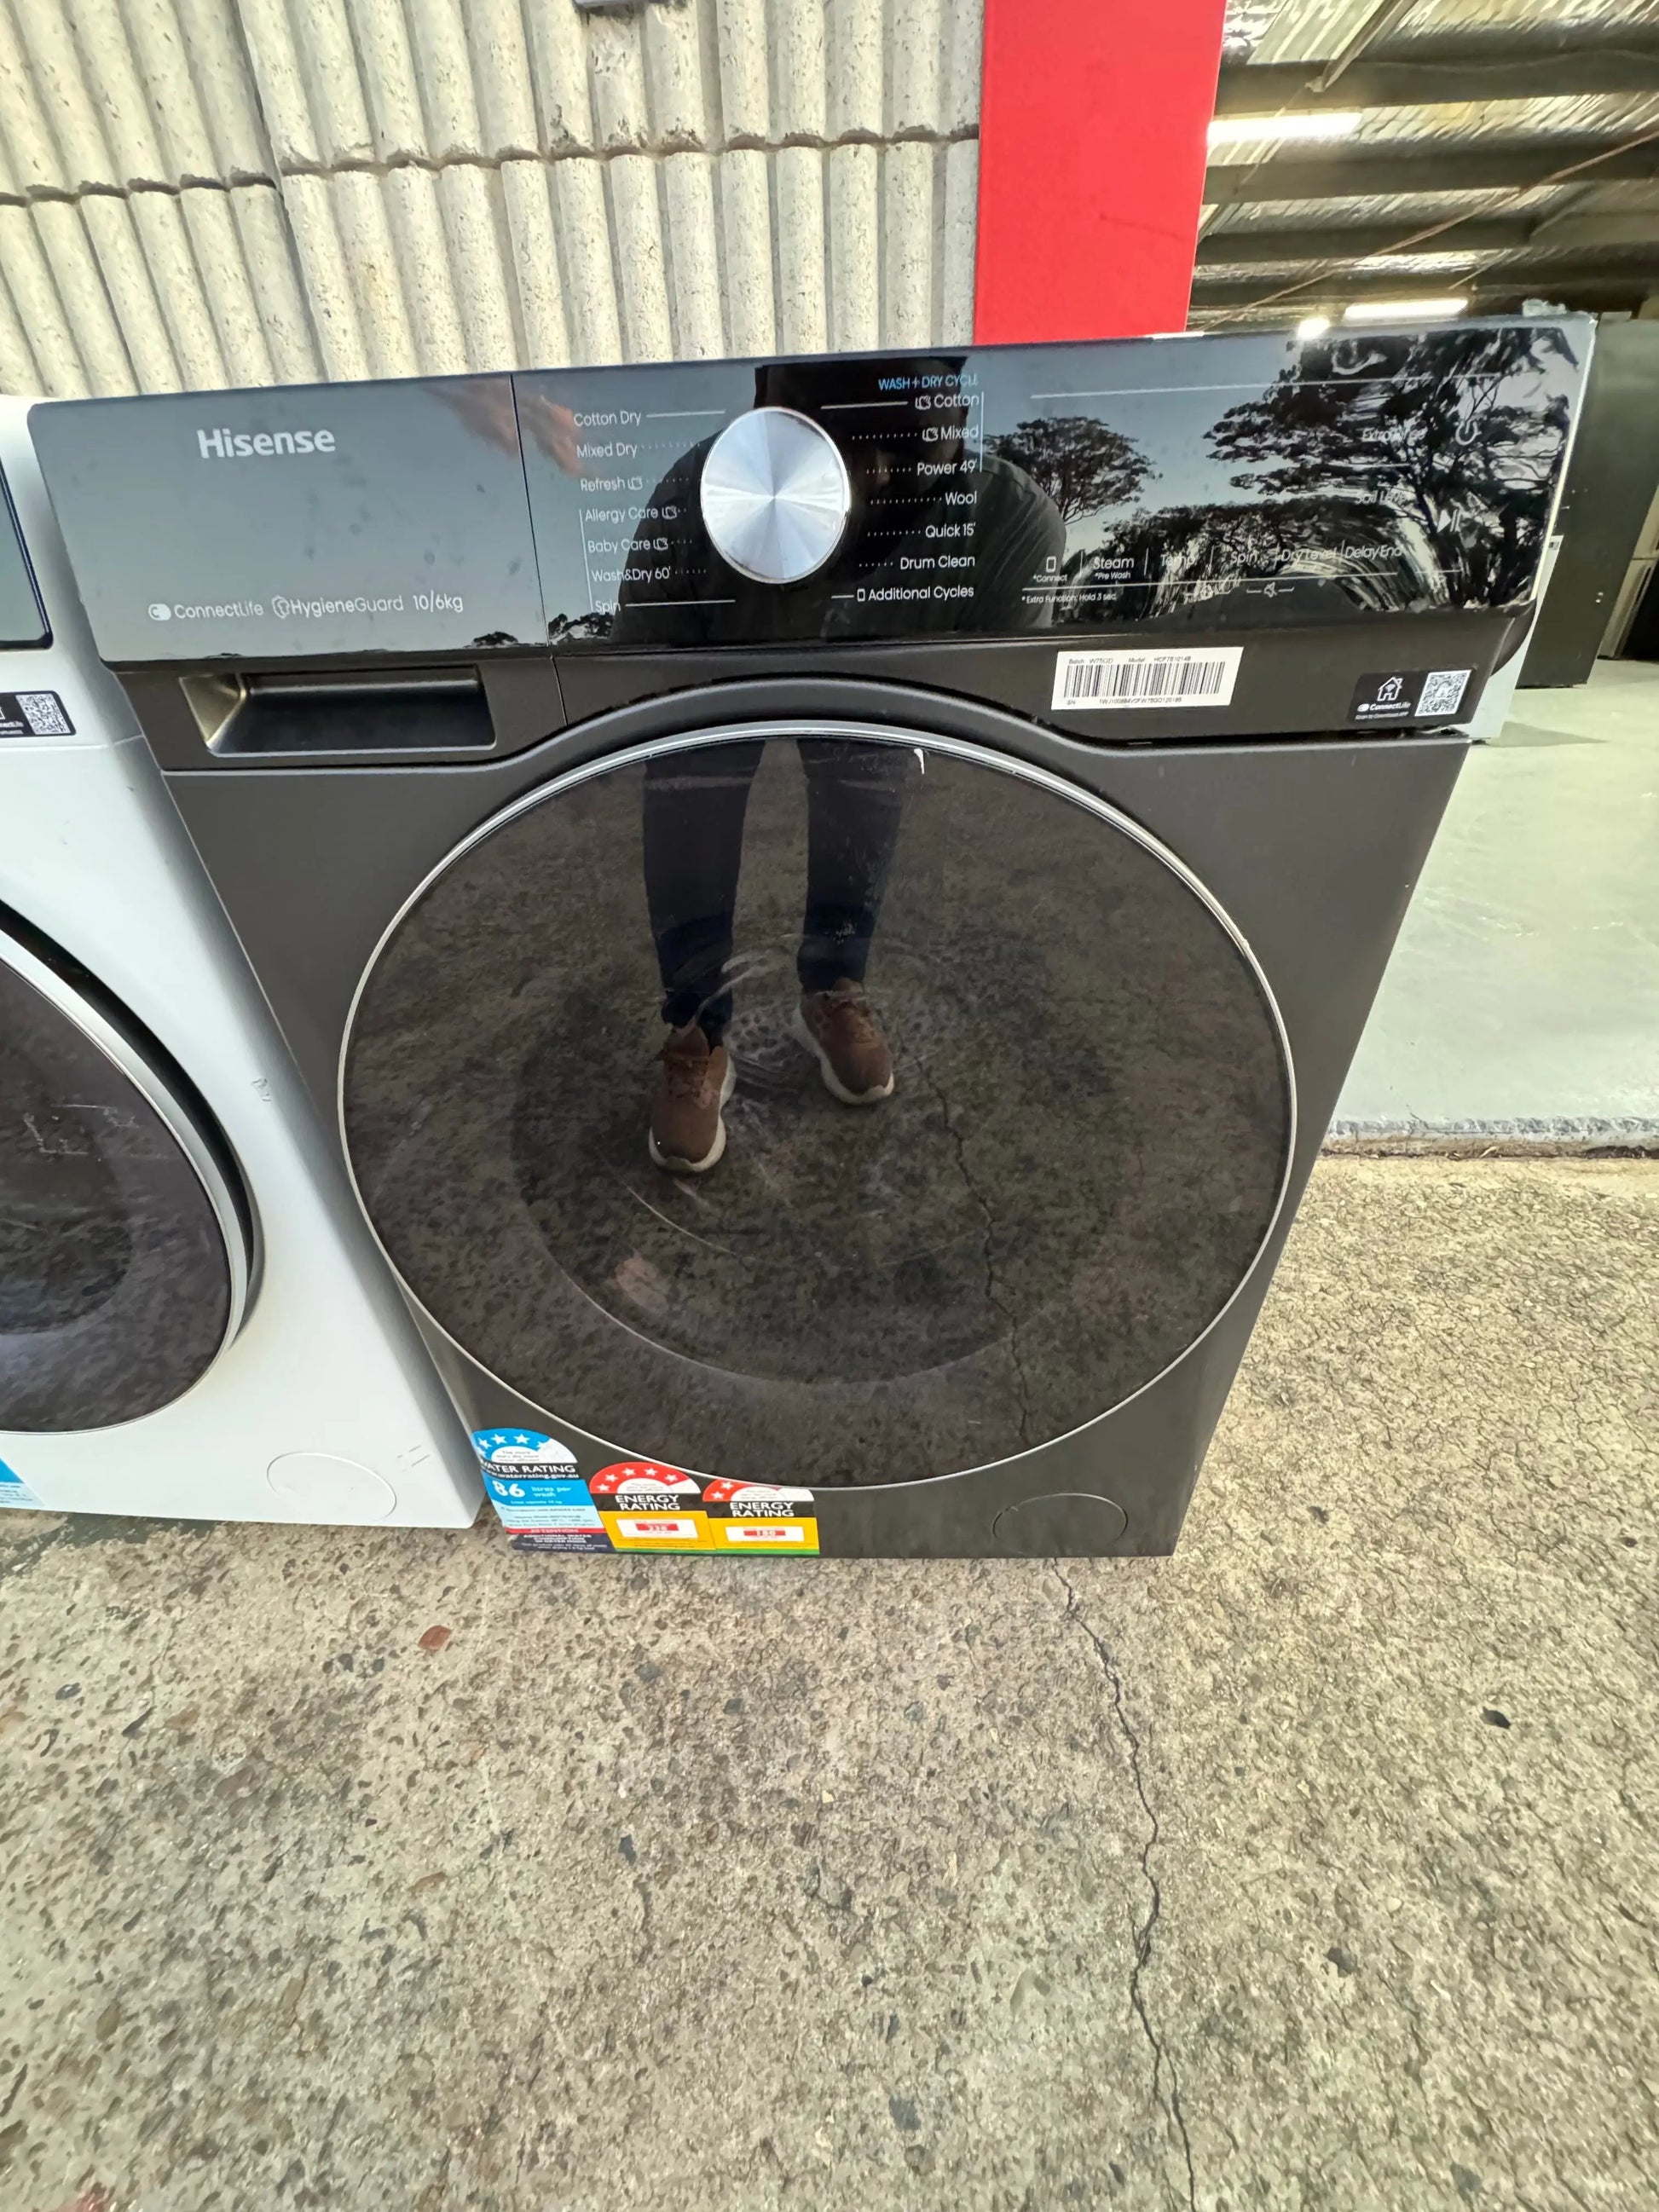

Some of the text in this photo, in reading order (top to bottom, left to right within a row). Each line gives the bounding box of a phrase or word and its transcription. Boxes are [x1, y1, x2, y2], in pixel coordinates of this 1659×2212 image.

[878, 378, 910, 390] WASH
[922, 375, 943, 388] DRY
[934, 394, 980, 408] Cotton
[573, 411, 641, 426] Cotton Dry
[940, 424, 980, 441] Mixed
[197, 428, 336, 459] Hisense
[576, 442, 638, 459] Mixed Dry
[917, 461, 957, 476] Power
[580, 476, 626, 492] Refresh
[945, 490, 977, 505] Wool
[585, 506, 659, 524] Allergy Care
[925, 523, 961, 538] Quick
[587, 538, 651, 554] Baby Care
[900, 554, 975, 569] Drum Clean
[1092, 557, 1135, 569] Steam
[1230, 552, 1258, 564] Spin
[1280, 550, 1304, 565] Dry
[591, 568, 652, 584] Wash&Dry
[1111, 571, 1131, 580] Wash
[868, 585, 974, 602] Additional Cycles
[1078, 592, 1096, 601] Hold
[175, 590, 464, 619] ConnectLife HygieneGuard 10/6kg
[595, 600, 621, 615] Spin
[521, 1464, 576, 1474] RATING
[492, 1481, 525, 1498] 86
[615, 1494, 679, 1503] ENERGY
